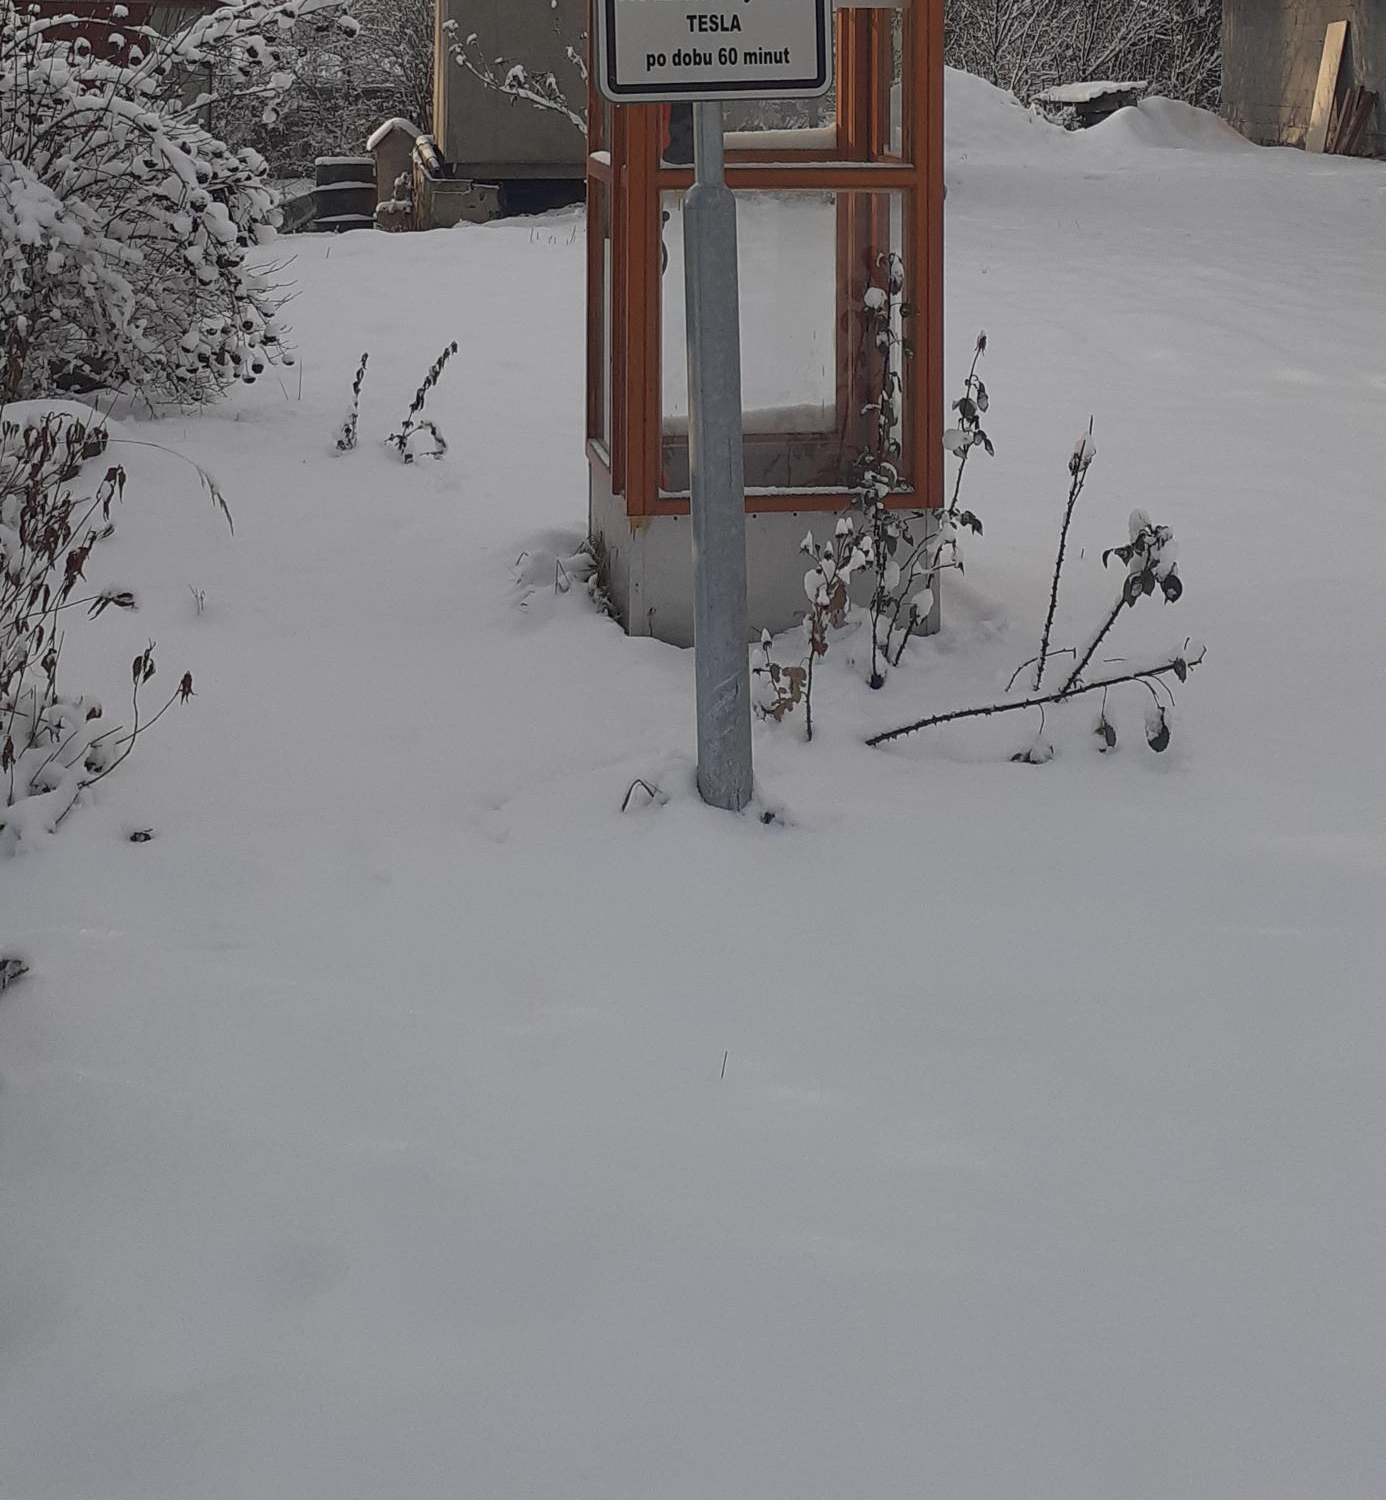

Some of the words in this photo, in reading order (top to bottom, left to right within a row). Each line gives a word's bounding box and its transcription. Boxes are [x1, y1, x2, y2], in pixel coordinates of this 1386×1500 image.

[687, 15, 741, 32] TESLA
[647, 54, 666, 71] po
[672, 48, 712, 66] dobu
[718, 48, 737, 65] 60
[744, 47, 789, 64] minut
